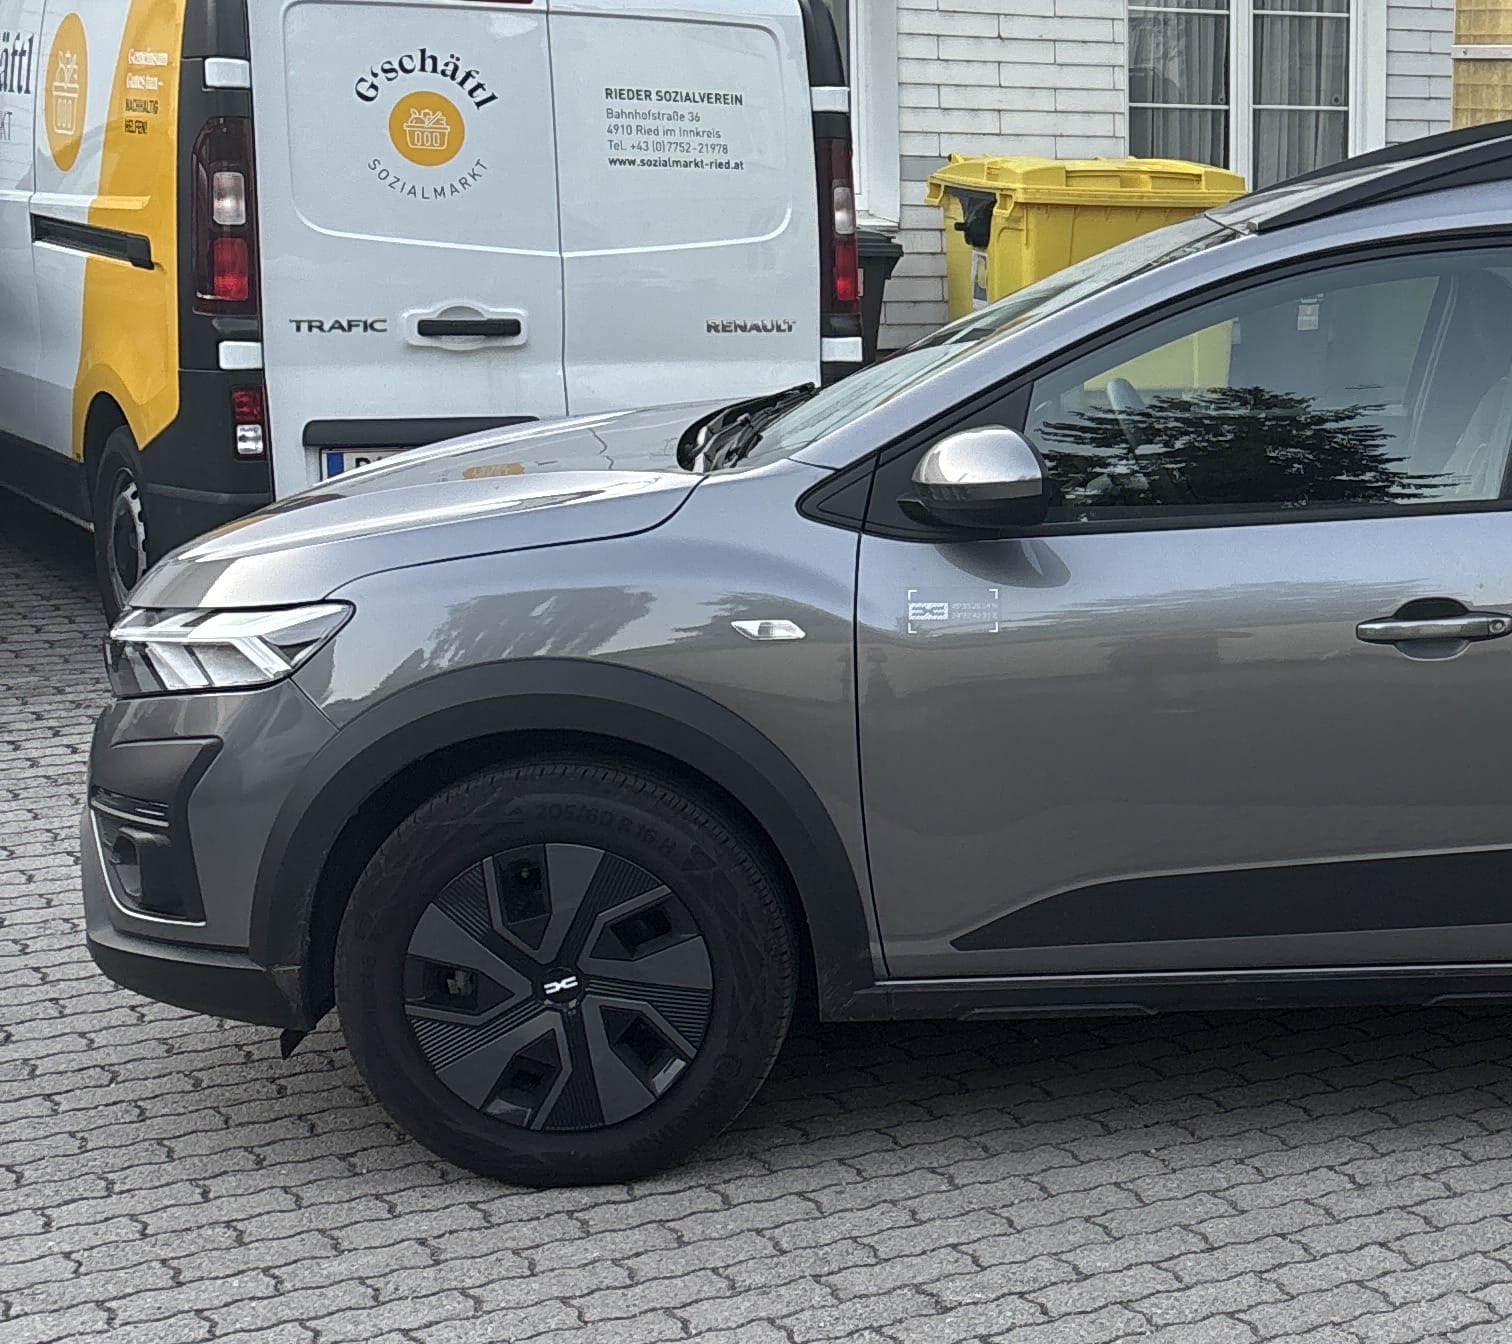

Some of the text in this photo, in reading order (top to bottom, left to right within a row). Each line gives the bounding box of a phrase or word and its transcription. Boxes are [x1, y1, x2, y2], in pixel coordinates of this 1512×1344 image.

[605, 87, 744, 106] RIEDER SOZIALVEREIN
[606, 107, 701, 123] Bahnhofstraße 36
[606, 123, 722, 139] 4910 Ried im Innkreis
[607, 139, 627, 151] Tel.
[629, 140, 650, 152] +43
[607, 156, 744, 171] www.sozialmarkt-ried.at
[367, 158, 488, 200] SOZIALMARKT
[289, 319, 388, 333] TRAFIC
[706, 319, 797, 333] RENAULT
